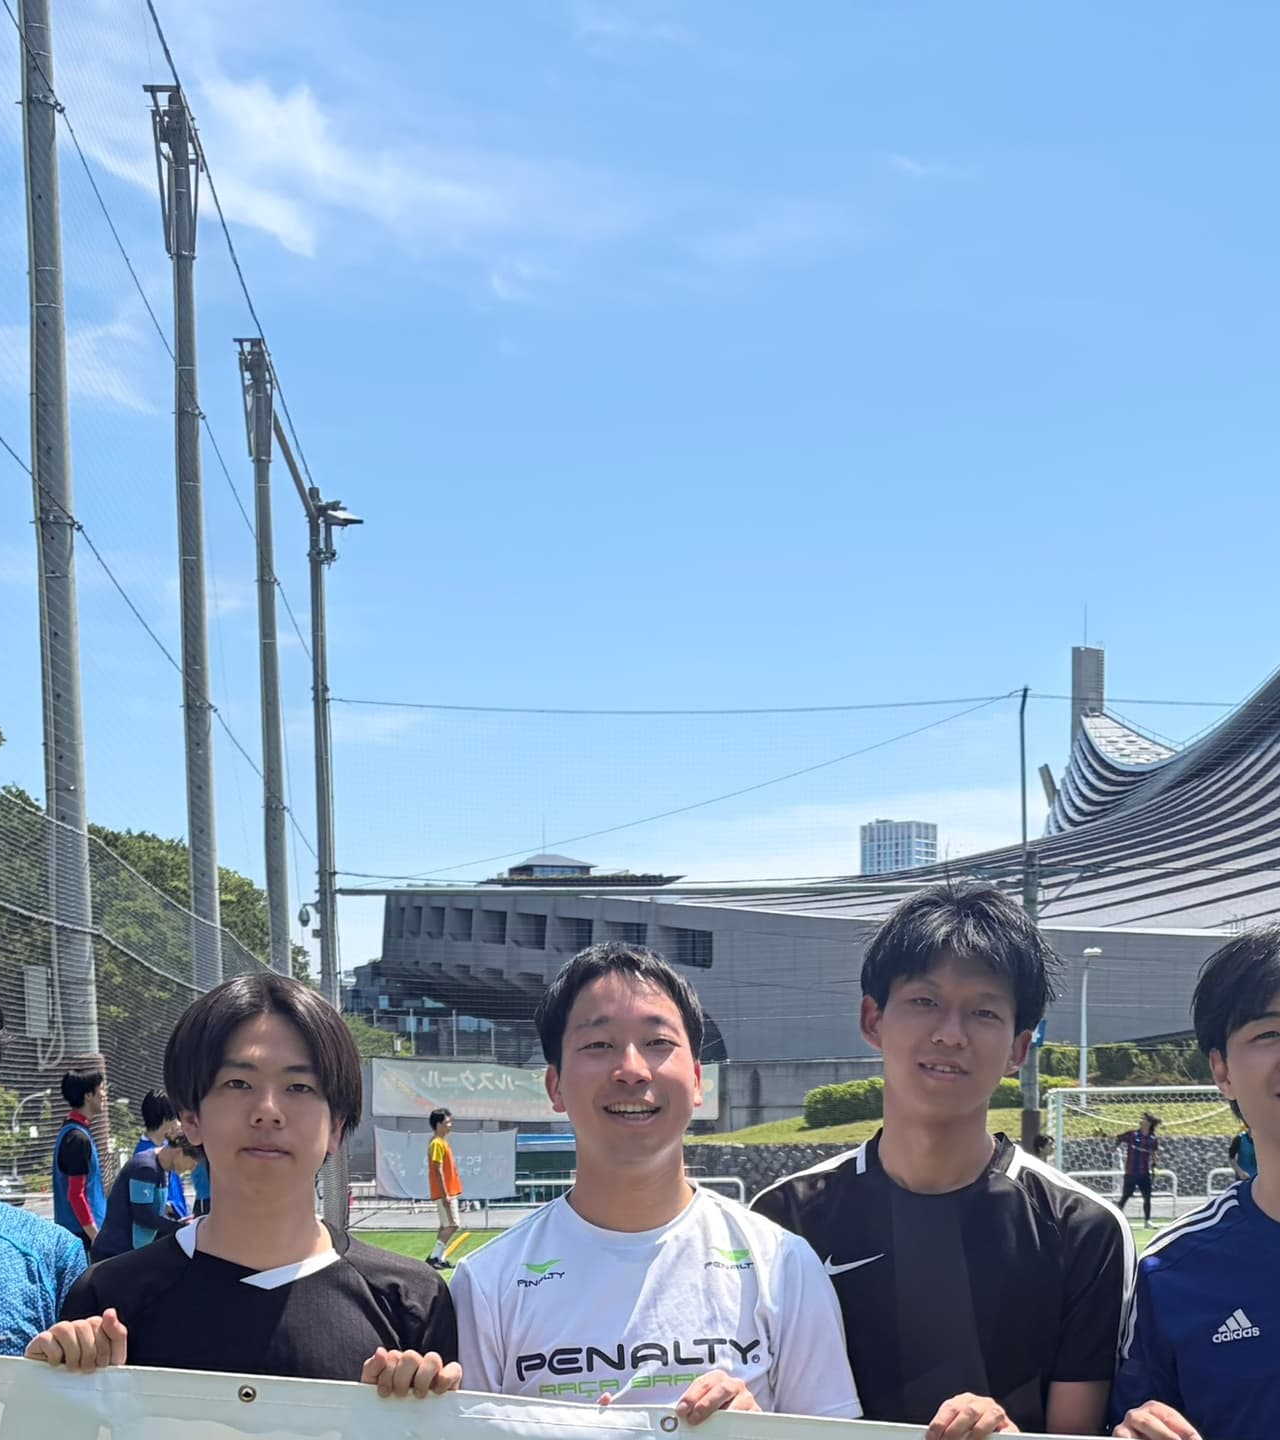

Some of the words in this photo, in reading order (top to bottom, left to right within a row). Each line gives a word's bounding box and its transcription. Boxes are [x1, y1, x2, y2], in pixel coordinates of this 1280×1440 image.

[1212, 1325, 1261, 1344] adidas
[516, 1338, 762, 1382] PENALTY
[631, 1373, 703, 1389] BRA
